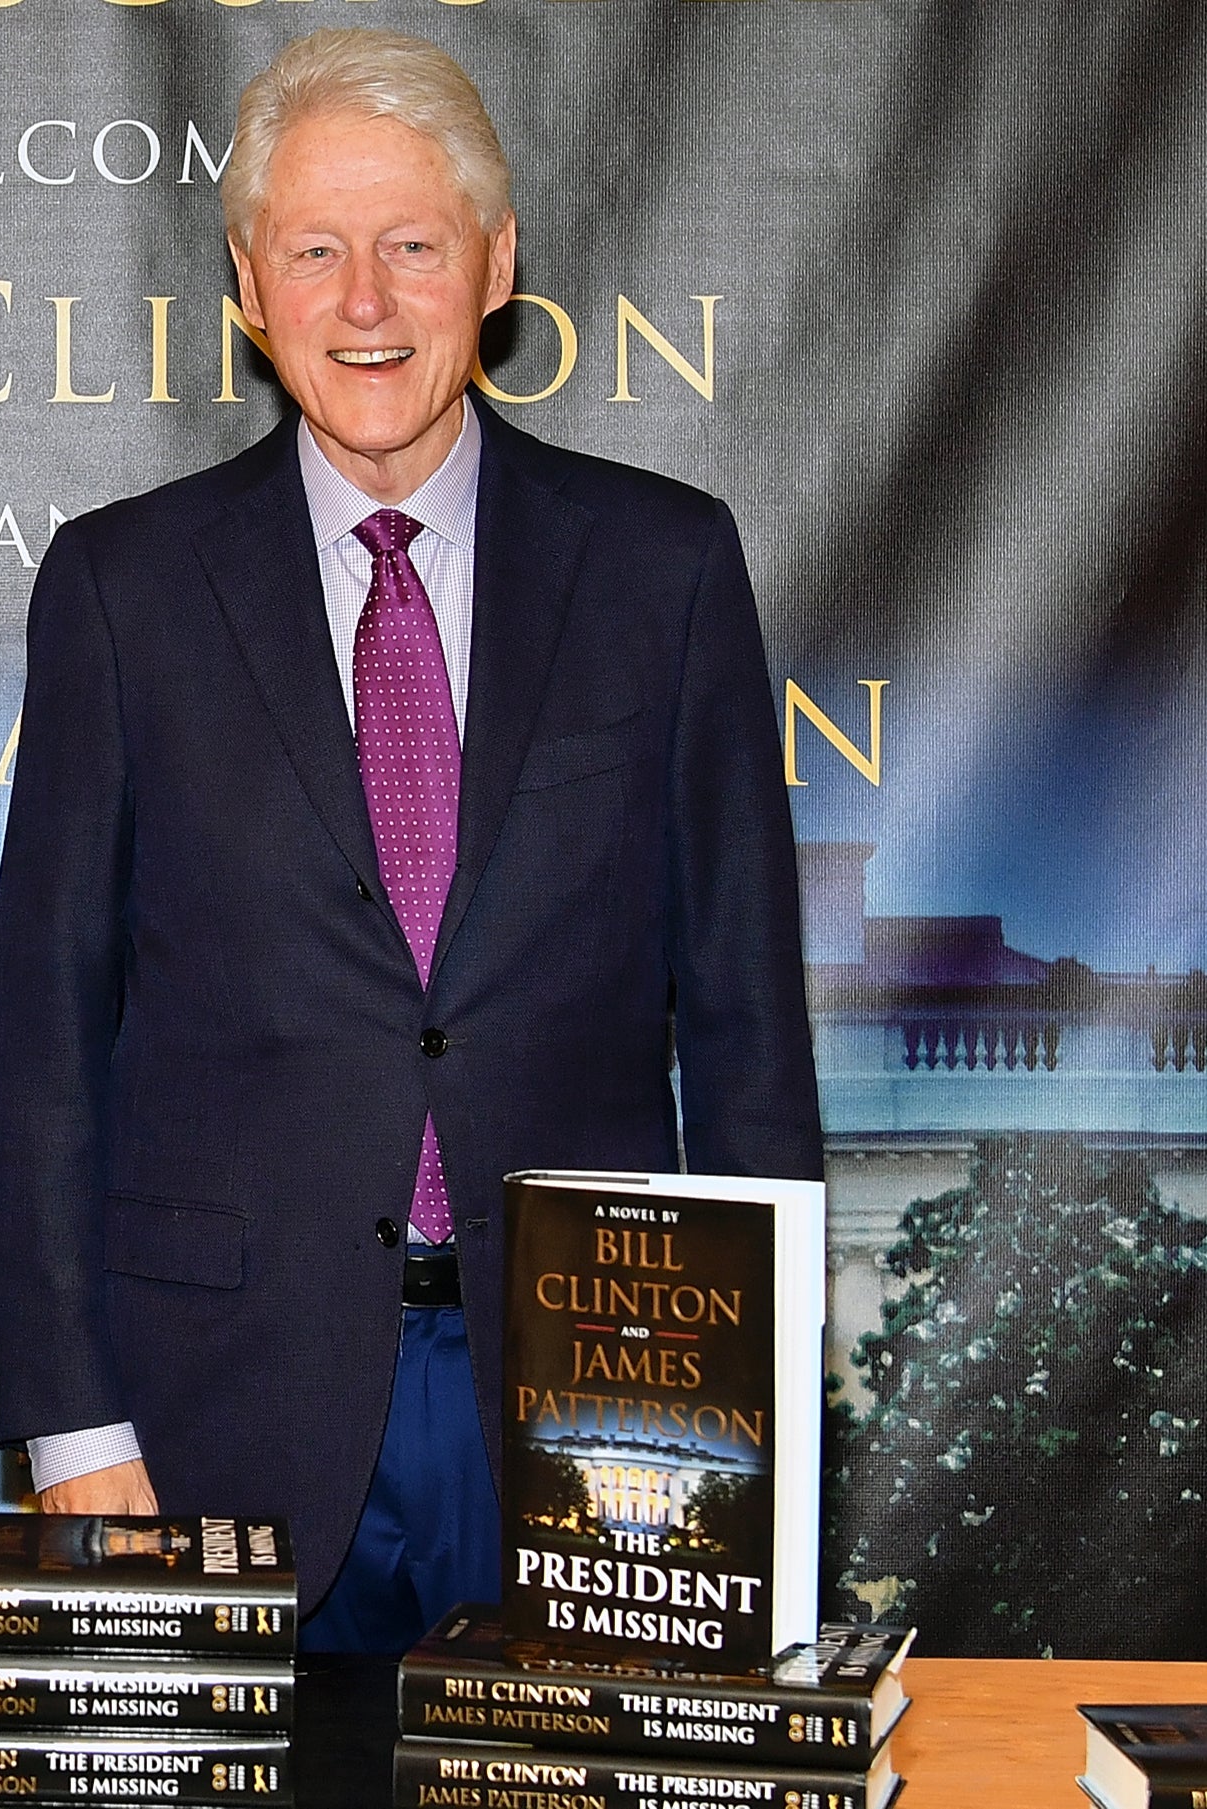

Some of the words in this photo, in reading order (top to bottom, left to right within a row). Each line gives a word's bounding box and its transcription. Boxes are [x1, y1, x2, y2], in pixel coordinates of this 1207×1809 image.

[594, 1205, 606, 1218] A
[609, 1206, 657, 1222] NOVEL
[662, 1211, 680, 1224] BY
[595, 1226, 684, 1271] BILL
[535, 1272, 742, 1326] CLINTON
[620, 1325, 650, 1339] AND
[571, 1340, 703, 1389] JAMES
[515, 1385, 764, 1447] PATTERSON
[609, 1529, 661, 1557] THE
[516, 1548, 762, 1614] PRESIDENT
[71, 1617, 91, 1635] IS
[93, 1618, 182, 1638] MISSING
[547, 1600, 577, 1630] IS
[581, 1604, 725, 1651] MISSING
[445, 1677, 486, 1700] BILL
[491, 1681, 591, 1708] CLINTON
[69, 1697, 89, 1715] IS
[91, 1698, 179, 1718] MISSING
[423, 1703, 487, 1726] JAMES
[492, 1708, 611, 1735] PATTERSON
[618, 1693, 663, 1714] THE
[665, 1696, 781, 1724] PRESIDENT
[643, 1719, 663, 1739] IS
[665, 1721, 756, 1746] MISSING
[45, 1751, 88, 1772] THE
[92, 1753, 204, 1774] PRESIDENT
[439, 1757, 481, 1781] BILL
[486, 1761, 587, 1787] CLINTON
[69, 1776, 89, 1795] IS
[91, 1777, 180, 1797] MISSING
[418, 1784, 481, 1809] JAMES
[487, 1788, 606, 1809] PATTERSON
[614, 1772, 658, 1794] THE
[661, 1775, 777, 1801] PRESIDENT
